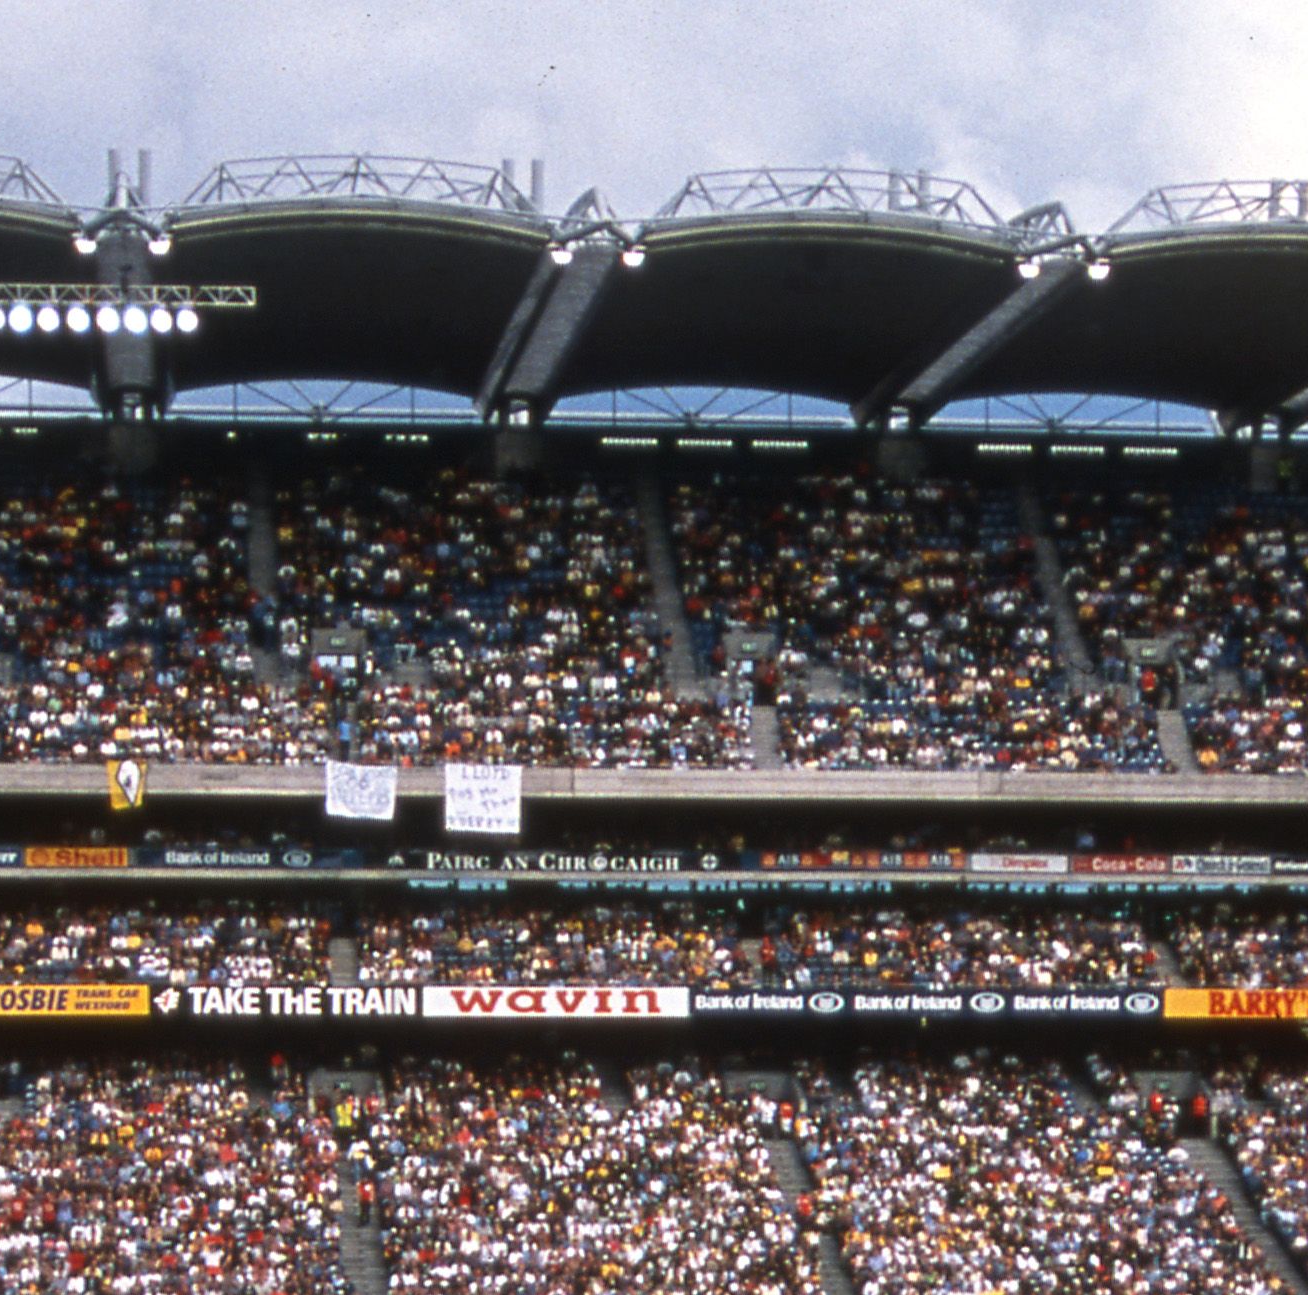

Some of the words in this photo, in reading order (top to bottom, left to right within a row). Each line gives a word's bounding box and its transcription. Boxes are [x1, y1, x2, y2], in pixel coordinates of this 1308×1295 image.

[55, 849, 124, 867] Shell
[165, 850, 203, 866] Bank
[204, 850, 219, 866] of
[221, 850, 271, 866] Ireland
[501, 855, 529, 870] AN
[188, 987, 260, 1014] TAKE
[266, 987, 322, 1014] THE
[327, 988, 417, 1014] TRAIN
[695, 994, 733, 1011] Bank
[735, 994, 749, 1011] of
[753, 994, 804, 1011] Ireland
[854, 994, 892, 1011] Bank
[894, 994, 910, 1011] of
[912, 994, 962, 1011] Ireland
[1014, 994, 1051, 1011] Bank
[1052, 994, 1067, 1012] of
[1070, 994, 1119, 1012] Ireland
